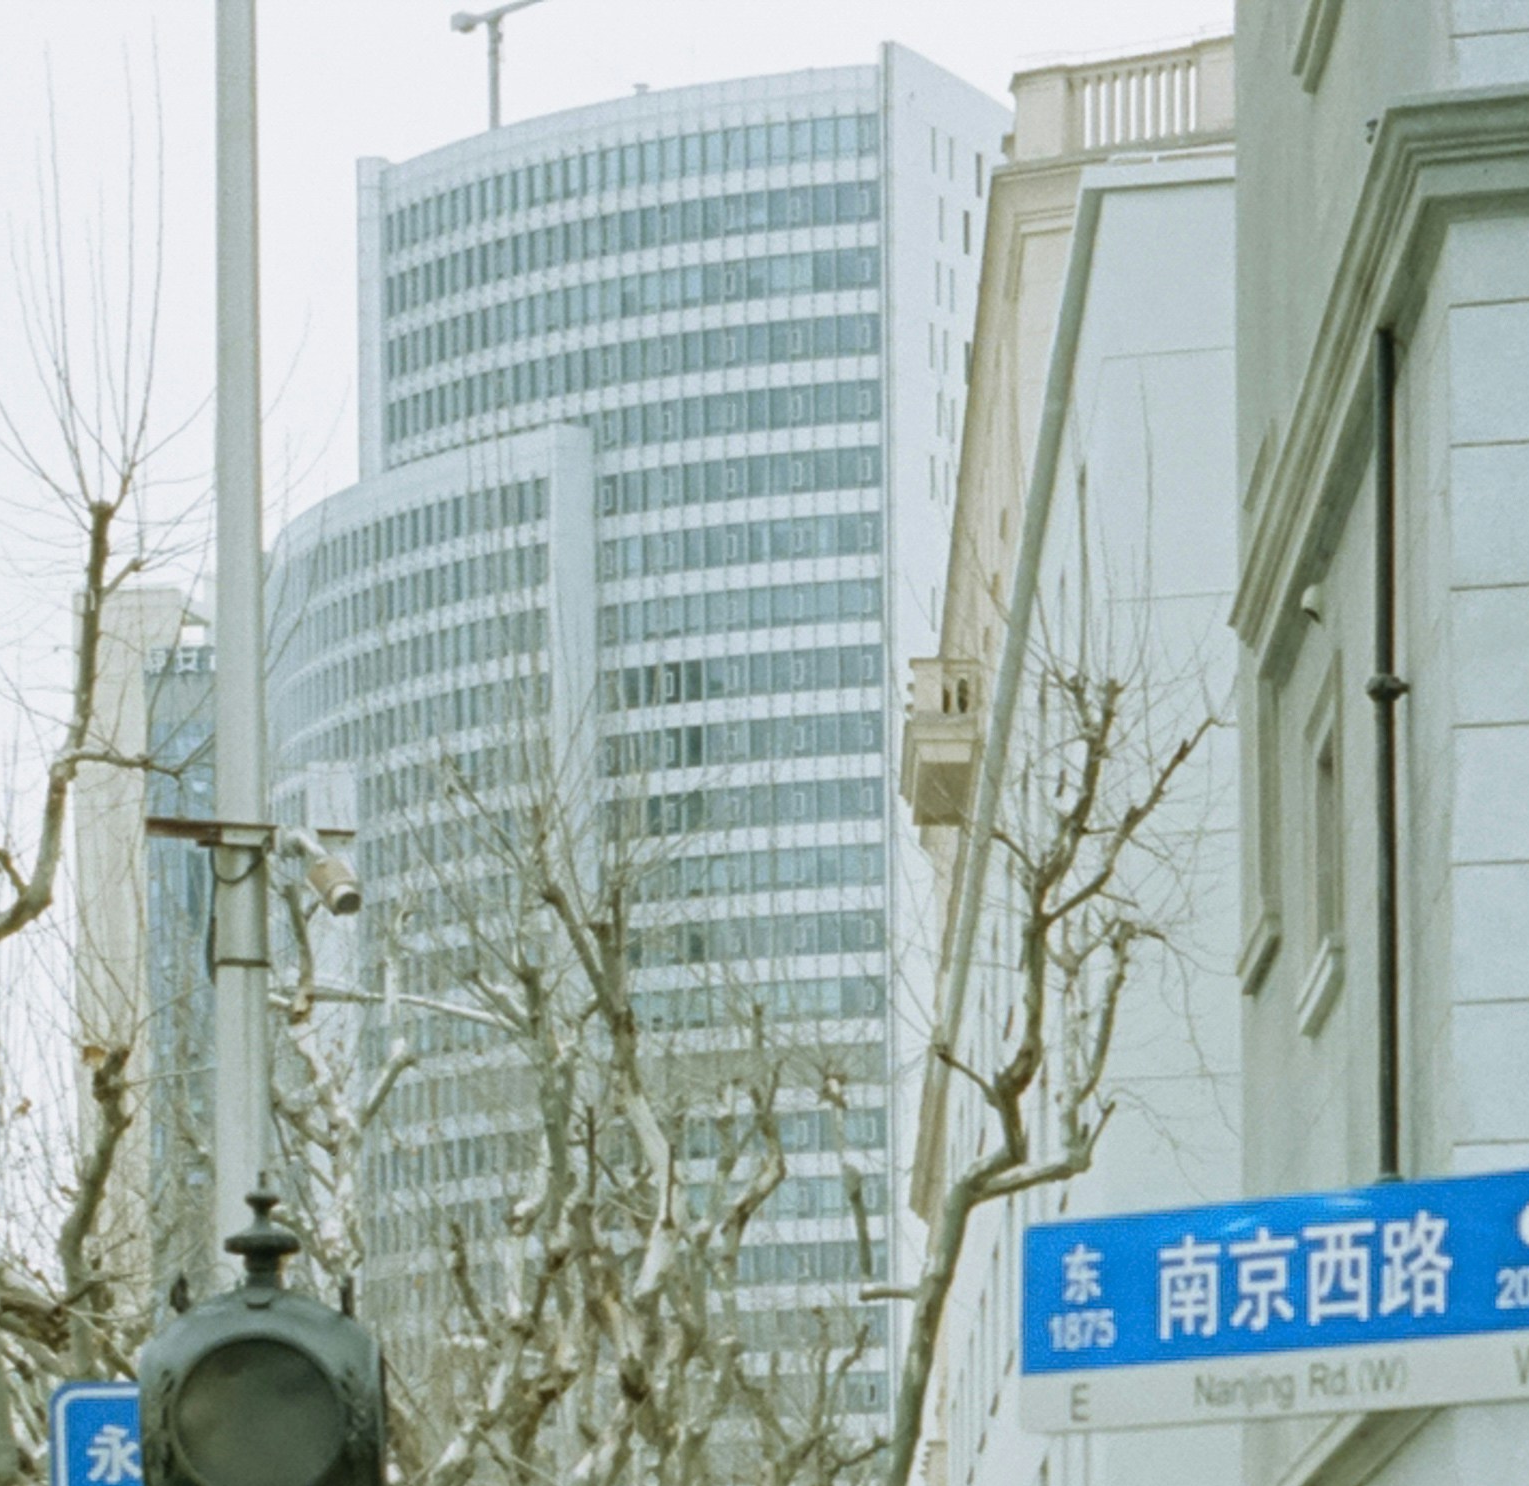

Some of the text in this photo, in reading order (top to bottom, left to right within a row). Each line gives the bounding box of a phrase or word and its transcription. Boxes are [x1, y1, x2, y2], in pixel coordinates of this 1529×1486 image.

[1061, 1242, 1105, 1304] 东
[1157, 1209, 1453, 1342] 南京西路
[1048, 1308, 1115, 1351] 1875
[1071, 1373, 1091, 1422] E
[1193, 1365, 1296, 1412] Nanjing
